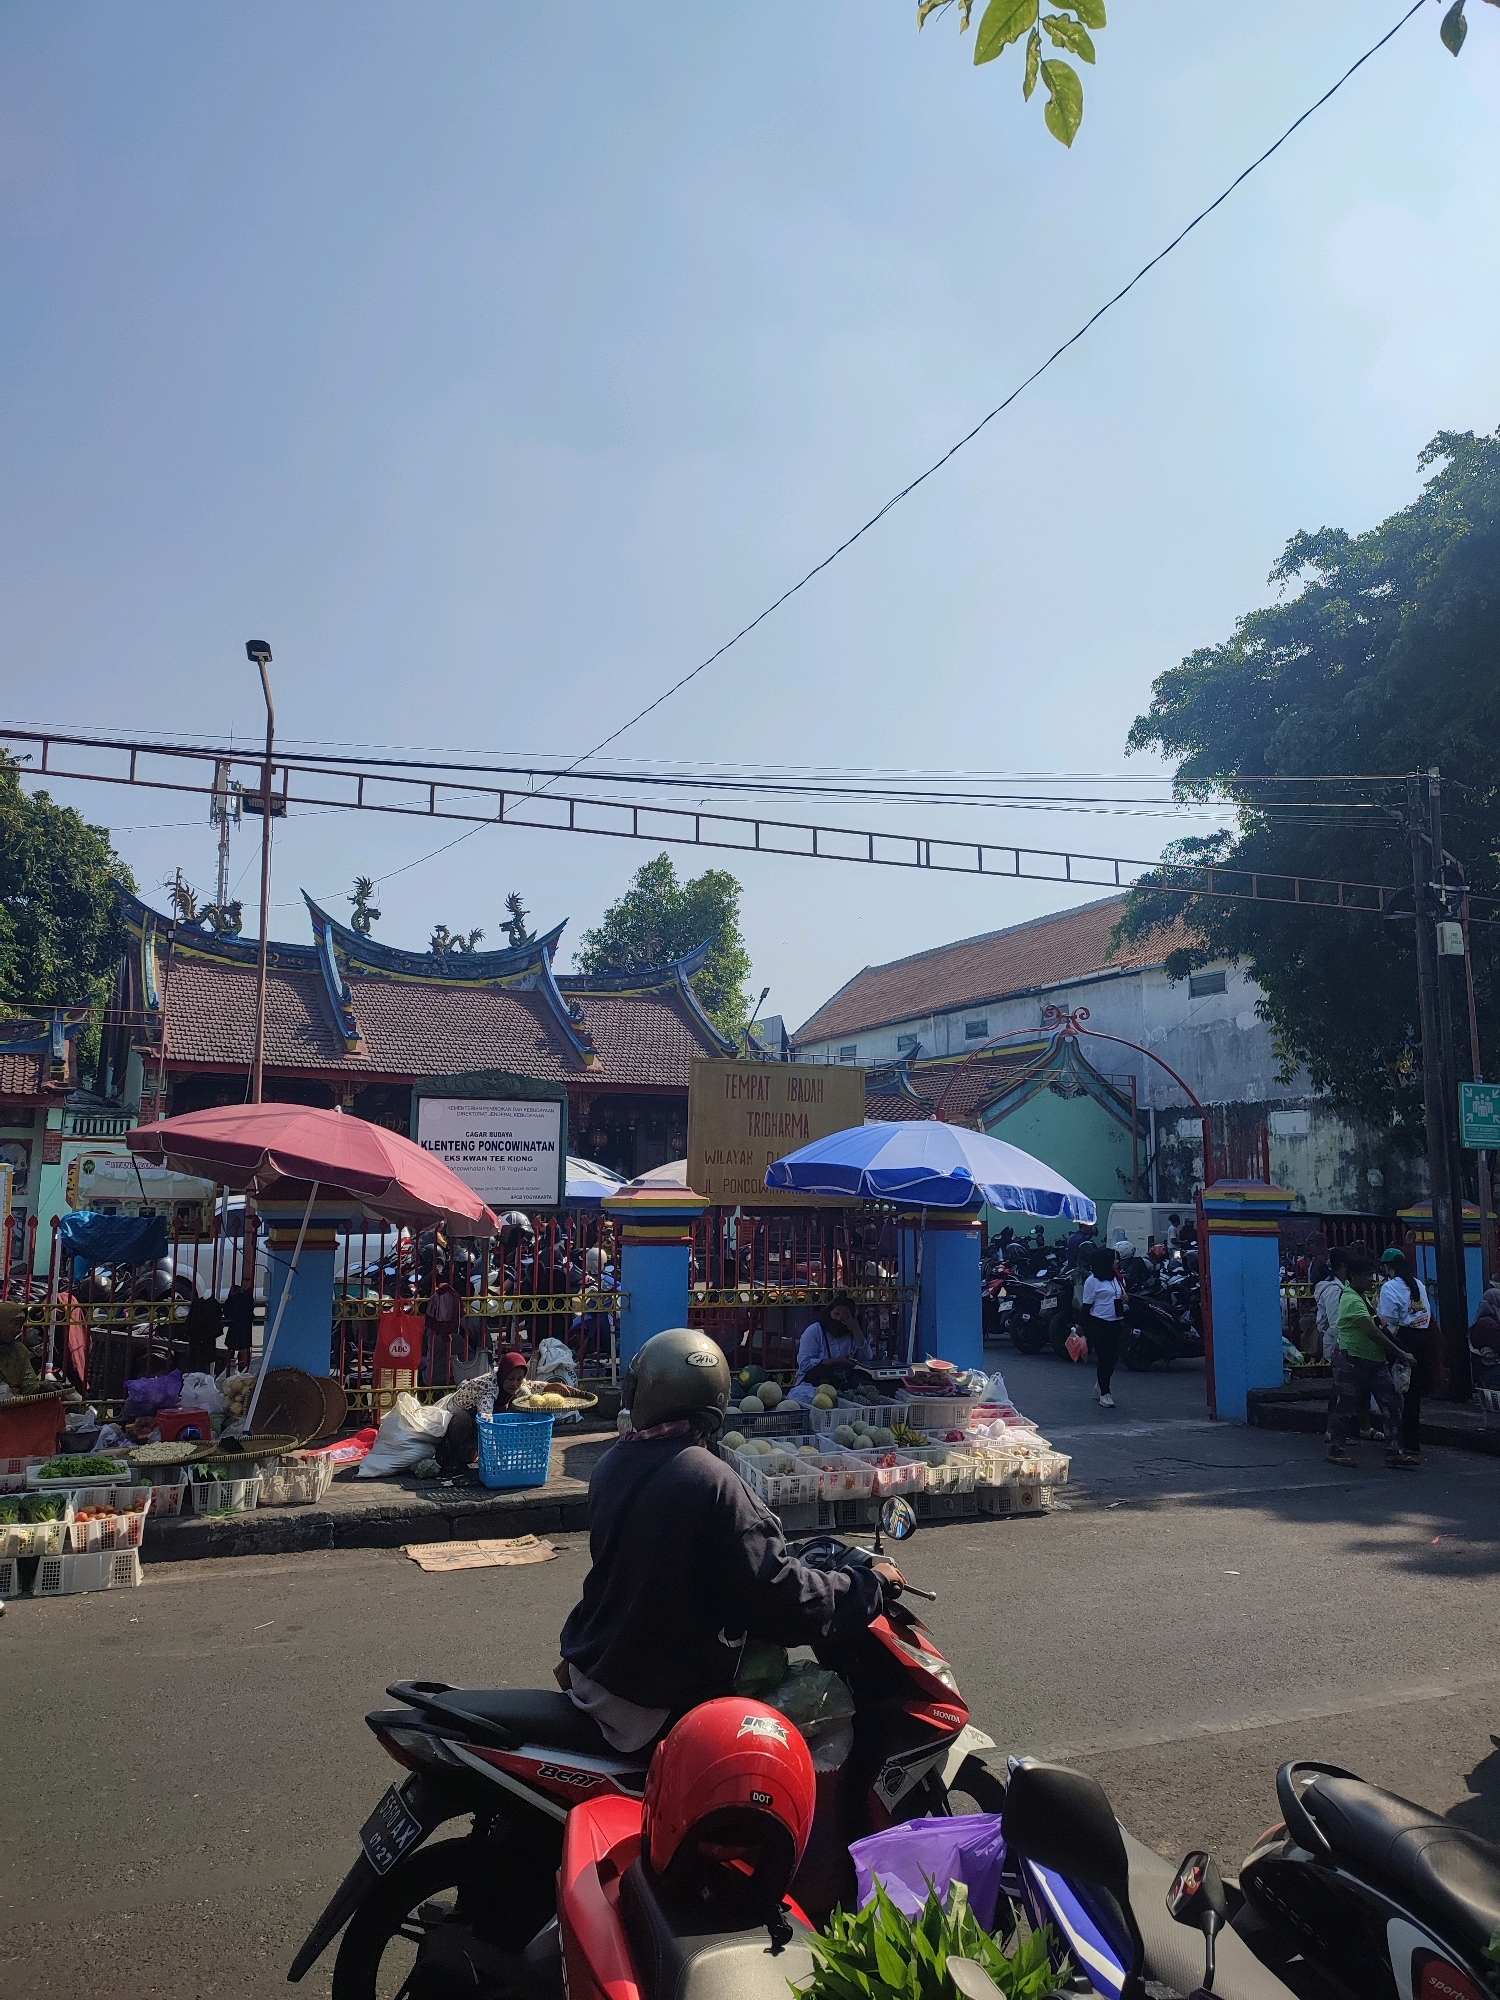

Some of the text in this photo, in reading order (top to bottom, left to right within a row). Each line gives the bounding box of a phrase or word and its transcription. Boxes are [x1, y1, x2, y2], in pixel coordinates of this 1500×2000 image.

[724, 1073, 824, 1103] TEMPAT IBADAH
[746, 1111, 810, 1139] TRIDHARMA
[420, 1140, 555, 1152] KLENTENG PONCOWINATAN
[702, 1178, 717, 1194] JL.
[391, 1345, 408, 1353] ABC
[933, 1709, 961, 1724] HONDA
[752, 1792, 771, 1804] DOT
